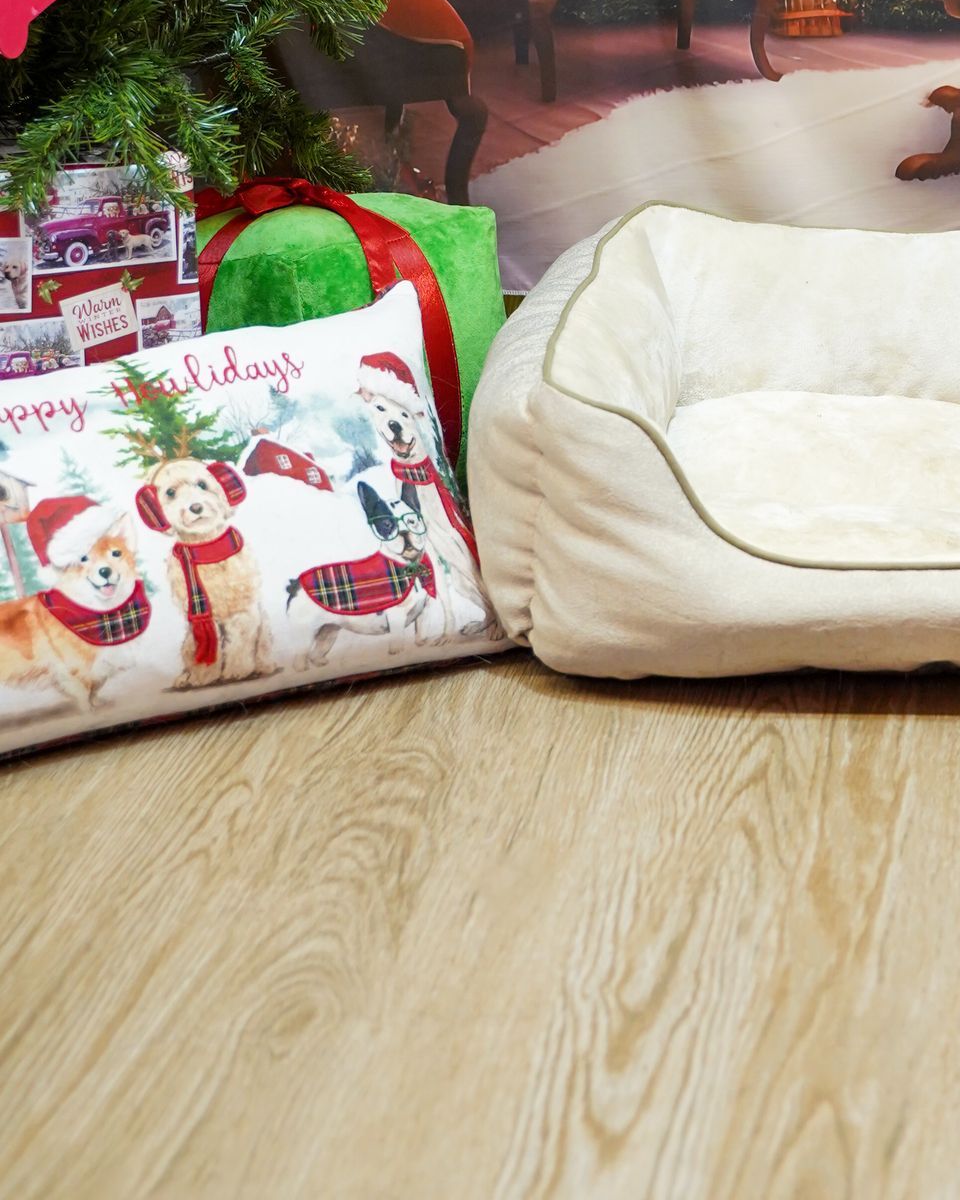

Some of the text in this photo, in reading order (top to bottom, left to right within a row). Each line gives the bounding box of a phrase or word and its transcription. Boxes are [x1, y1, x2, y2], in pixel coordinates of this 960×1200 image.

[72, 297, 121, 319] Warm
[76, 314, 129, 342] WISHES
[0, 345, 305, 434] ppy Howlidays
